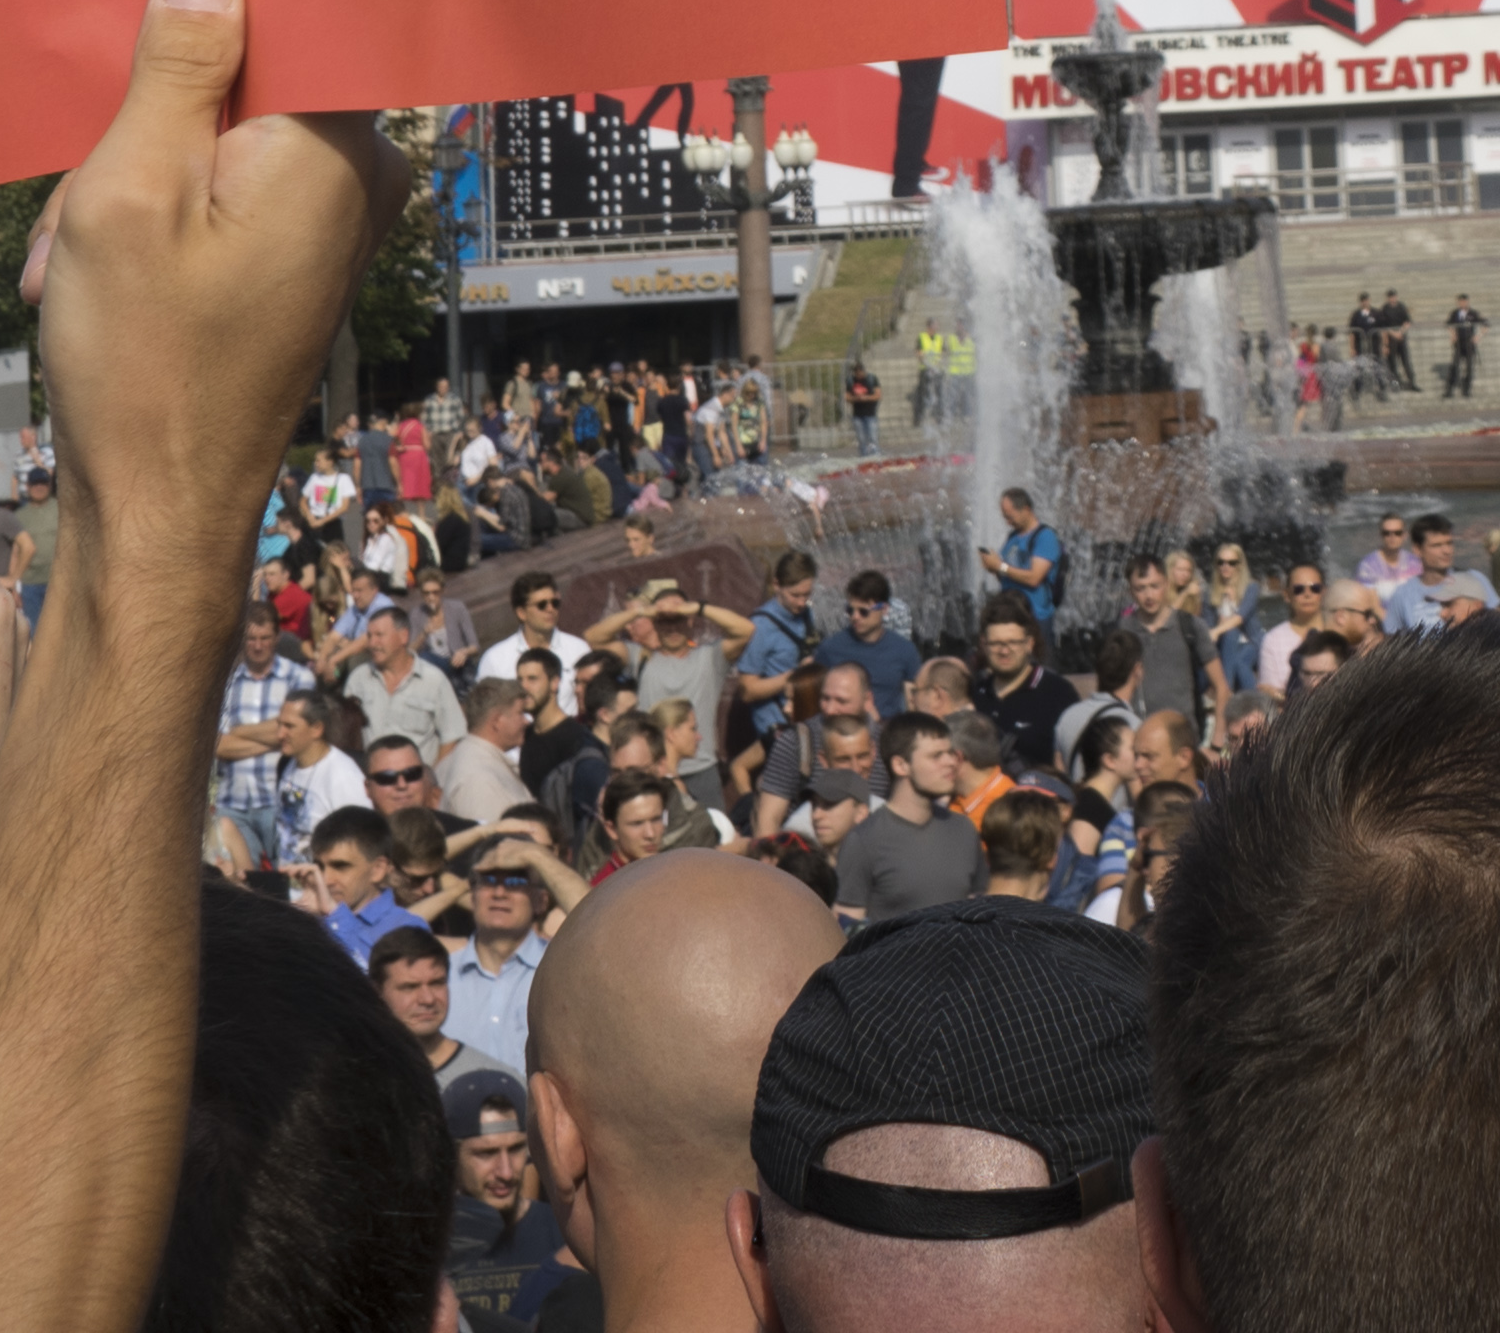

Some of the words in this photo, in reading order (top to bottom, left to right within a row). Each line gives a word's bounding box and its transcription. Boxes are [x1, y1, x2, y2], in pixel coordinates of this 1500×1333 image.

[1012, 44, 1042, 58] THE
[1217, 32, 1291, 49] THEATRE
[1011, 52, 1325, 110] МОВСКИЙ
[1337, 51, 1470, 92] ТЕАТР
[611, 266, 740, 297] ЧАЙХОН
